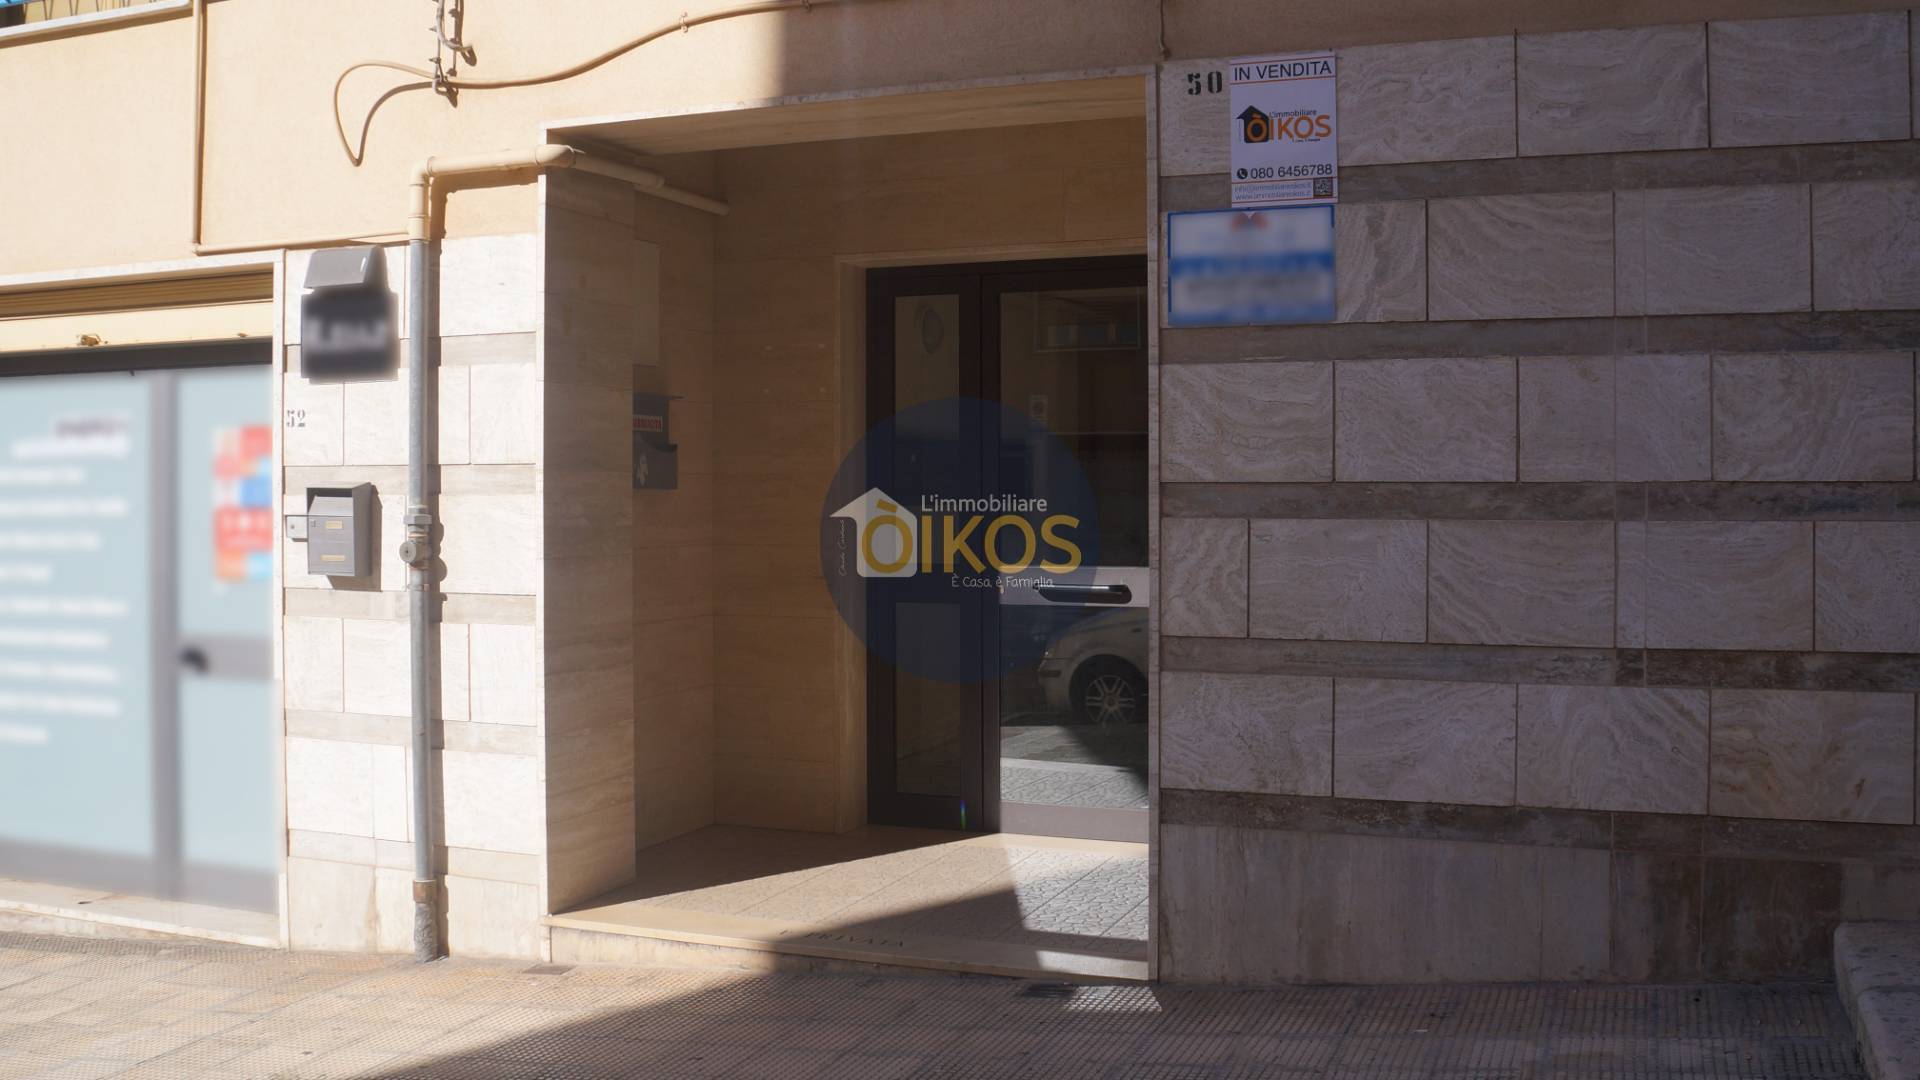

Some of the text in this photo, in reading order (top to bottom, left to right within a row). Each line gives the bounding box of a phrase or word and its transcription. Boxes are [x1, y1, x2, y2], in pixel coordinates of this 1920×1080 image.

[1234, 60, 1332, 81] IN VENDITA
[1187, 71, 1223, 95] 50
[1250, 163, 1333, 179] 080 6456788
[286, 409, 306, 428] 52
